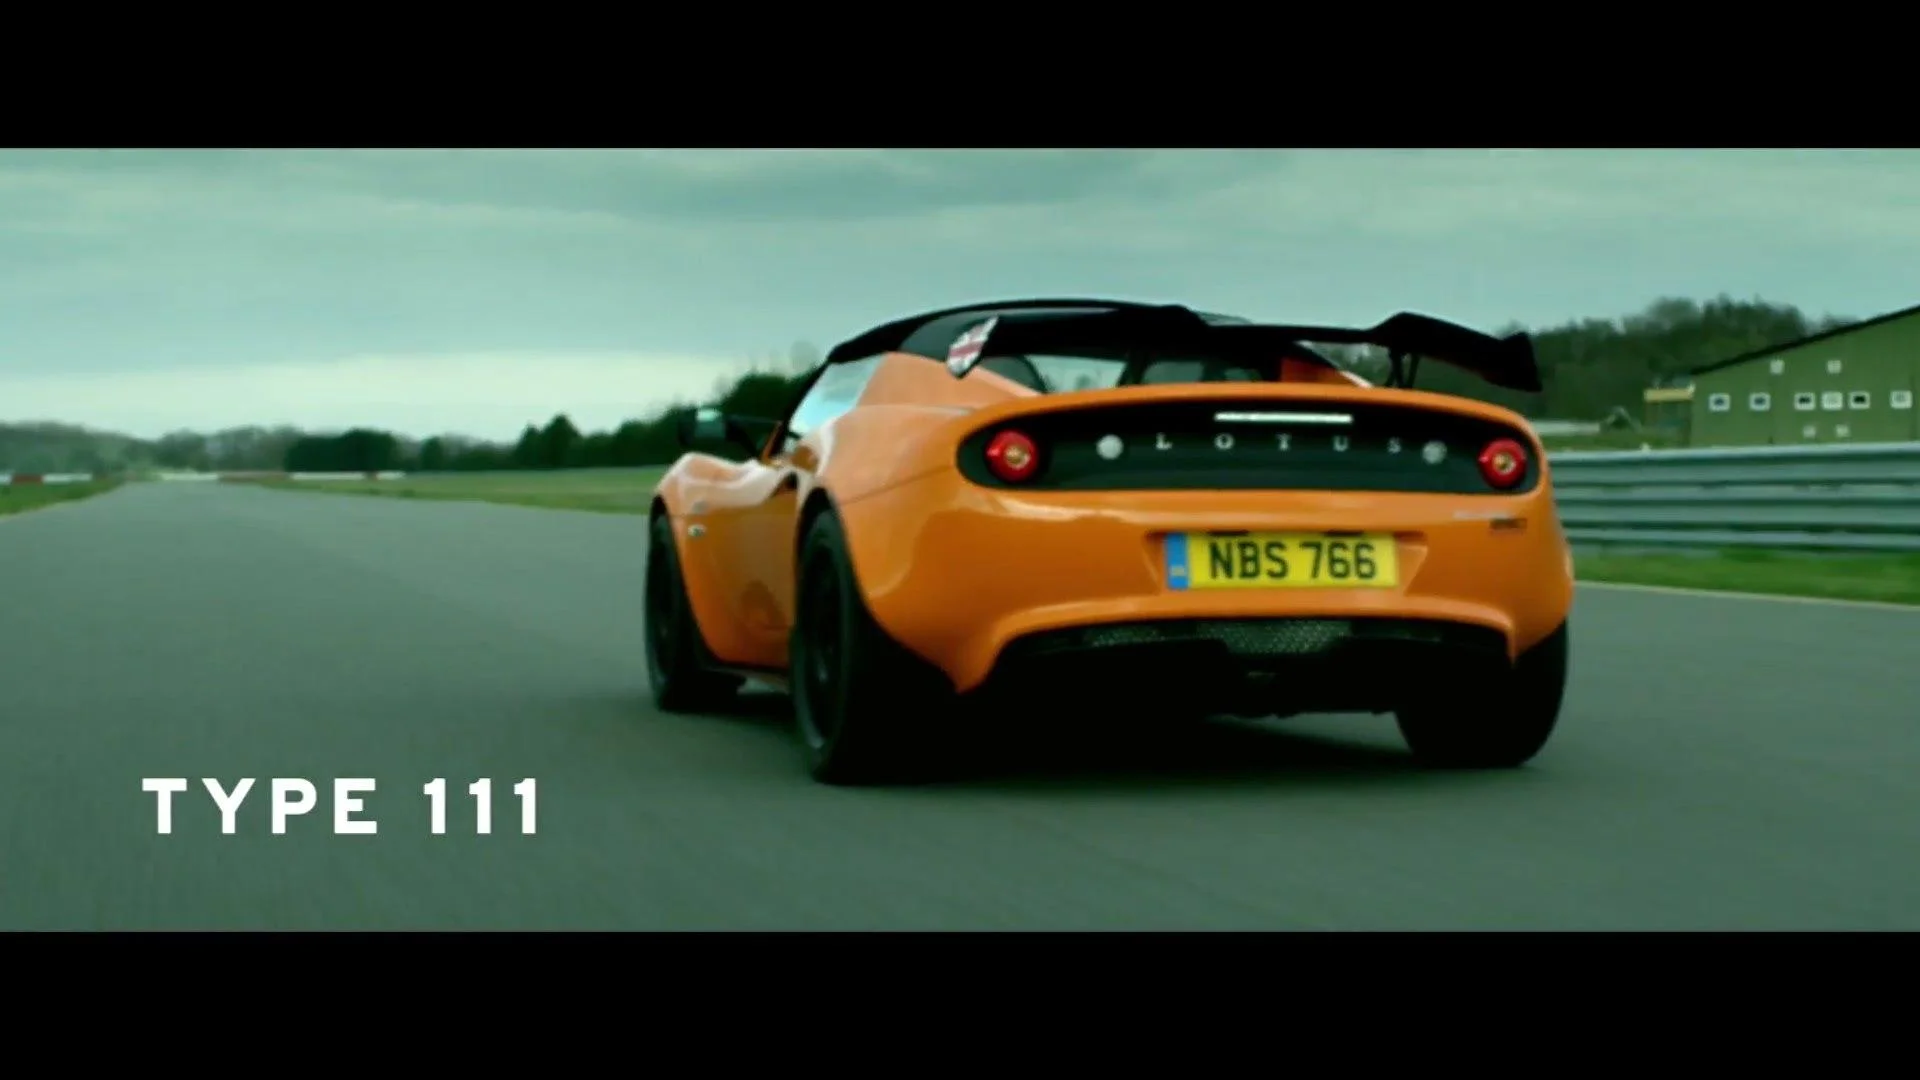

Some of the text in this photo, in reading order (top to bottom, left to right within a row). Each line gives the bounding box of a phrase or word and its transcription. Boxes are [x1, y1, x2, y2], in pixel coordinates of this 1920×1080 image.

[1156, 433, 1401, 454] LOTUS
[1209, 541, 1377, 579] NBS 766
